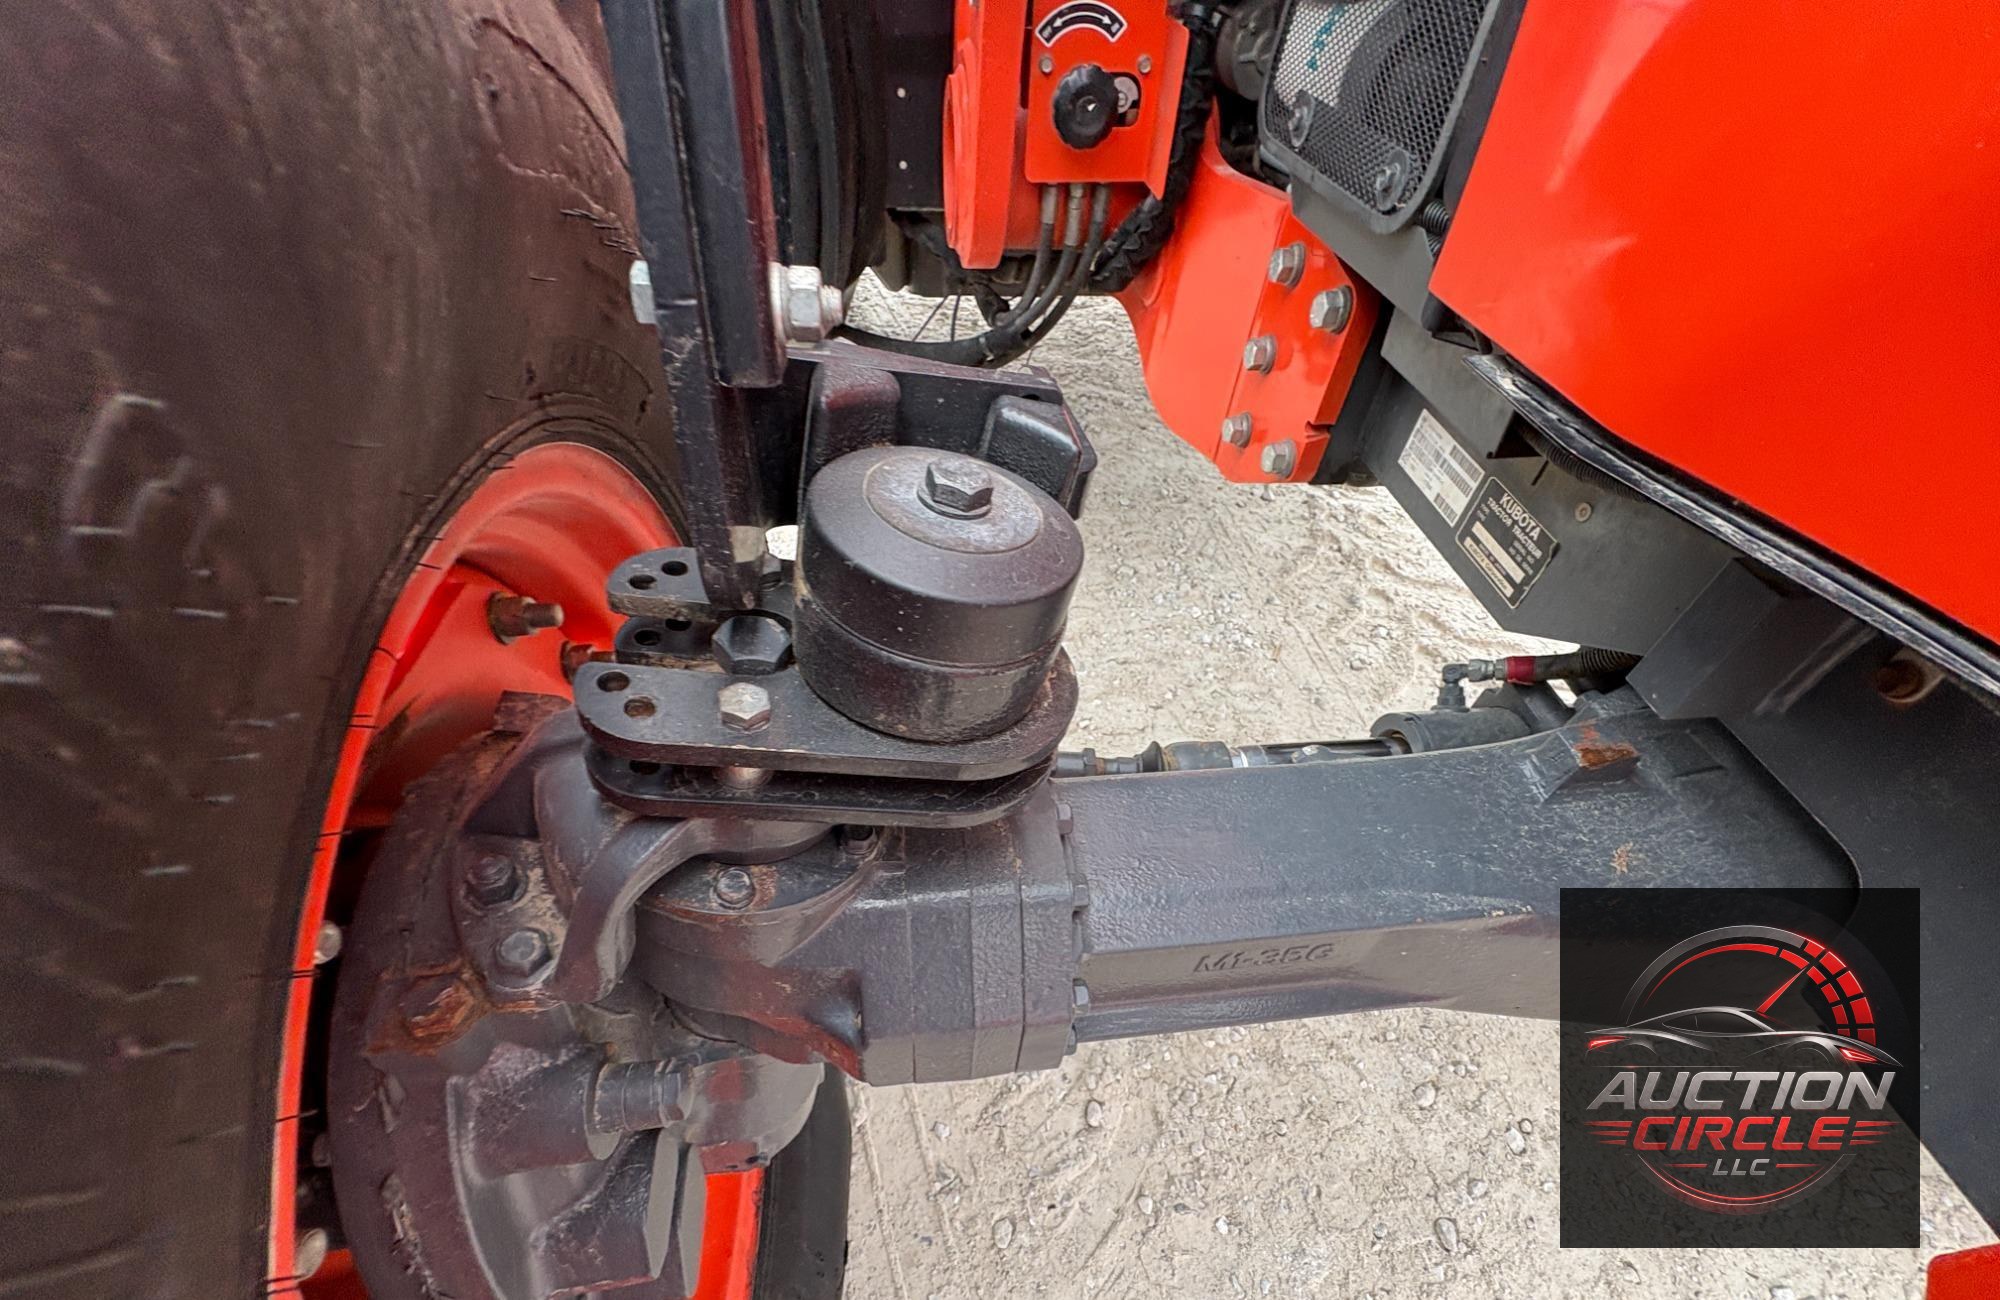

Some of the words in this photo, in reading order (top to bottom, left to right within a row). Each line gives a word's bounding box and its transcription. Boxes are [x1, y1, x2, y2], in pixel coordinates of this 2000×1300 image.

[1487, 497, 1513, 527] TRACTOR
[1512, 525, 1542, 559] TRACTEUR
[1499, 492, 1541, 541] KUBOTA
